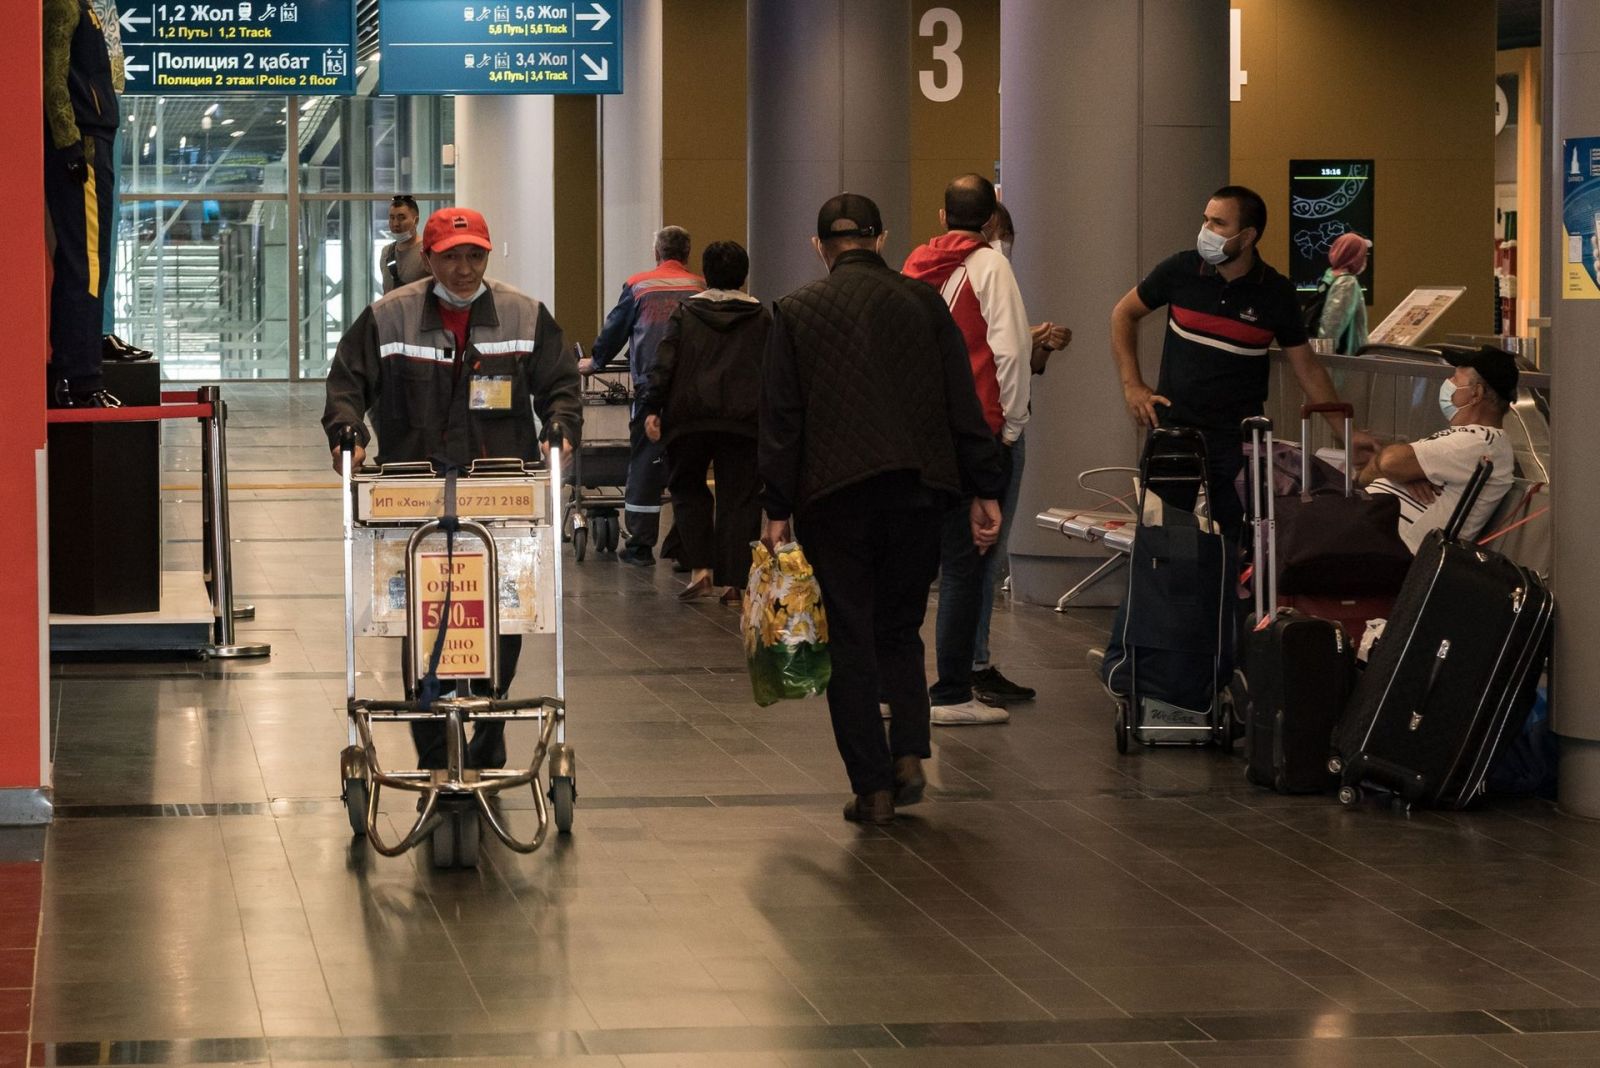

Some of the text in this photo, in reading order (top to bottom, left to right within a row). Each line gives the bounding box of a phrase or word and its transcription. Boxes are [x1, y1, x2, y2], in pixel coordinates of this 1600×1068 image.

[158, 5, 234, 22] 1,2 Жол
[515, 6, 568, 20] 5,6 Жол
[158, 27, 209, 39] 1,2 Путь
[218, 27, 272, 38] 1,2 Track
[488, 24, 502, 35] 5,6
[530, 24, 568, 35] 5,6 Track
[516, 53, 568, 67] 3,4 Жол
[919, 8, 963, 102] 3
[158, 53, 310, 71] Полиция 2 қабат
[158, 75, 255, 87] Полиция 2 этаж
[259, 74, 337, 85] Police 2 floor
[489, 71, 503, 82] 3,4
[531, 71, 568, 82] 3,4 Track
[375, 497, 394, 508] ИП
[476, 496, 497, 507] 721
[501, 495, 530, 507] 2188
